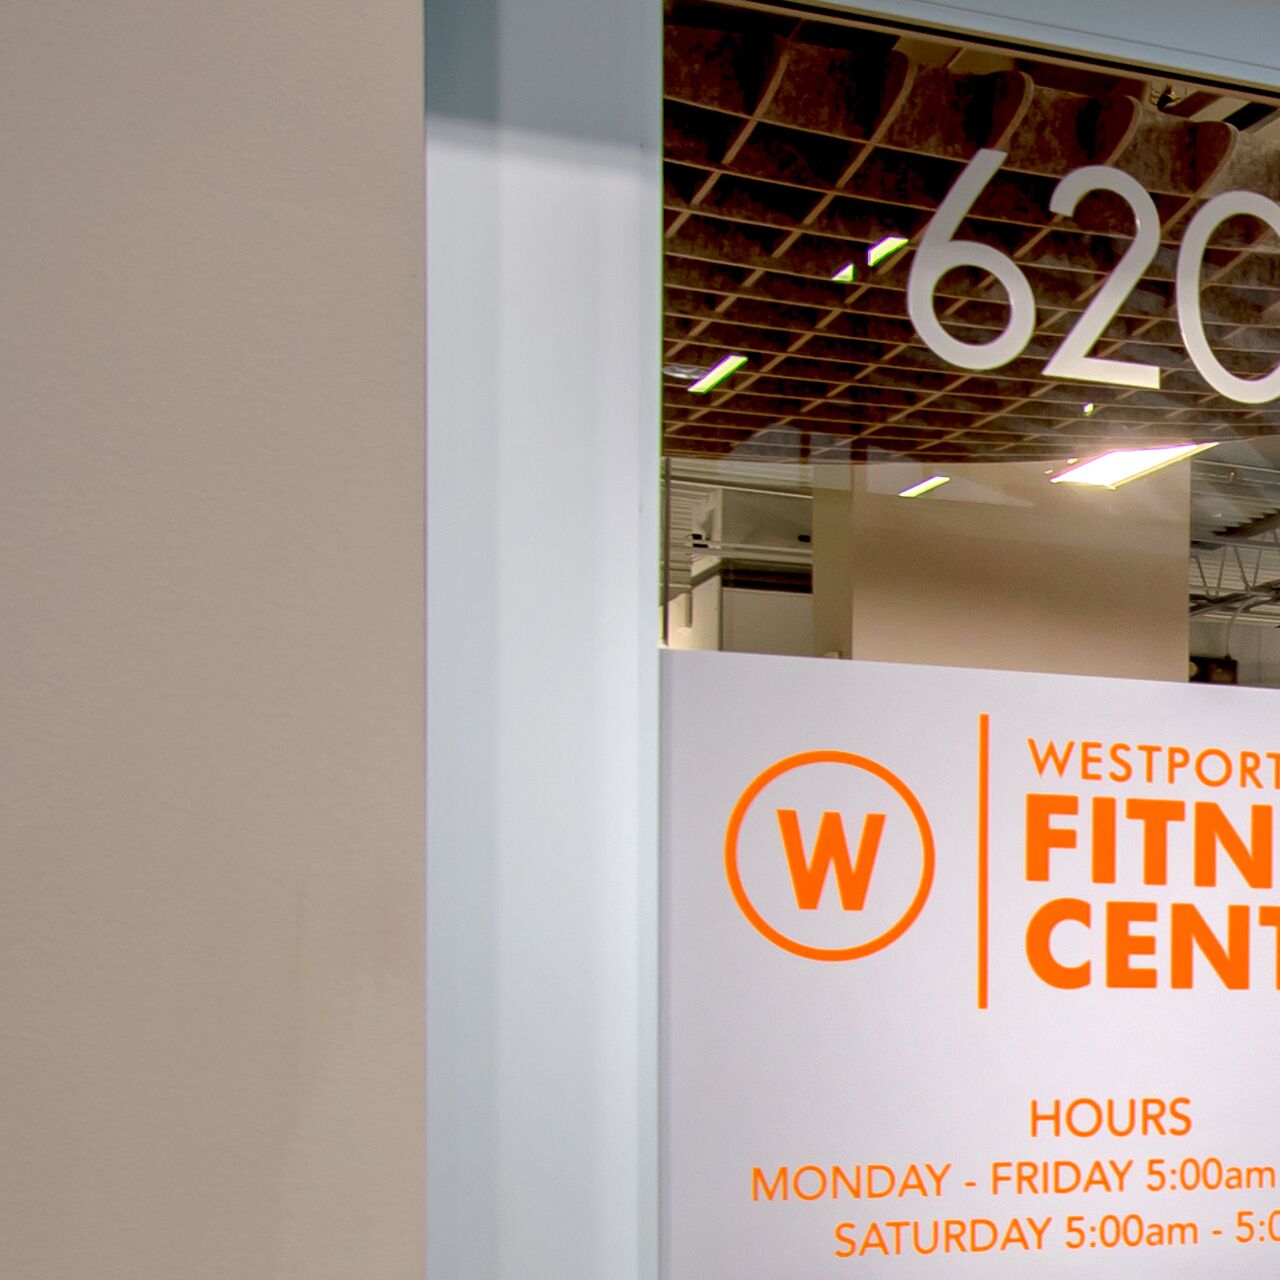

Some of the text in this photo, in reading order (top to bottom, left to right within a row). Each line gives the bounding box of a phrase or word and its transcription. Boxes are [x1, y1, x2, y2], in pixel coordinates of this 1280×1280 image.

[774, 807, 887, 913] W
[1029, 1096, 1193, 1139] HOURS
[751, 1162, 953, 1202] MONDAY
[990, 1158, 1134, 1197] FRIDAY
[1145, 1156, 1277, 1193] 5:00am
[833, 1215, 1052, 1259] SATURDAY
[1064, 1212, 1199, 1250] 5:00am
